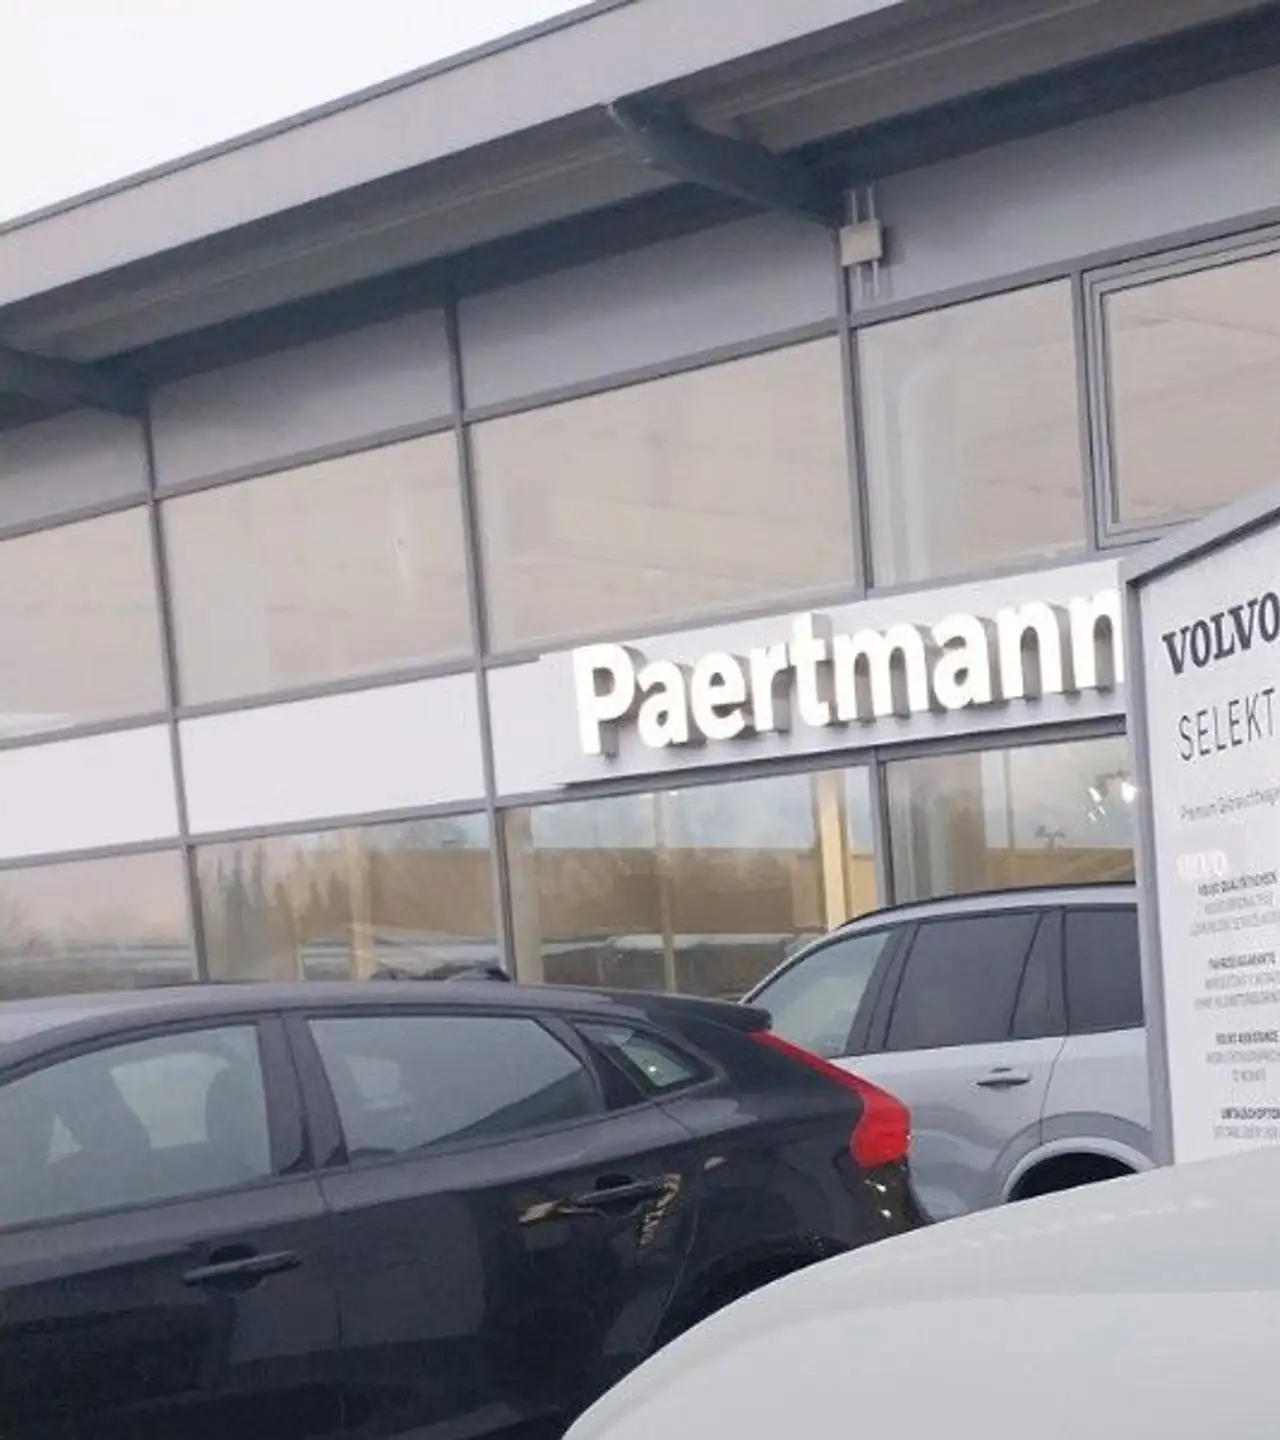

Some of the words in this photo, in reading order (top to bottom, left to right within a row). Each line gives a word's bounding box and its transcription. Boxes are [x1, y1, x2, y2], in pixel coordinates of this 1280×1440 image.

[572, 589, 1125, 756] Paertmann
[1161, 591, 1280, 676] VOLVO
[1178, 687, 1276, 762] SELEKT
